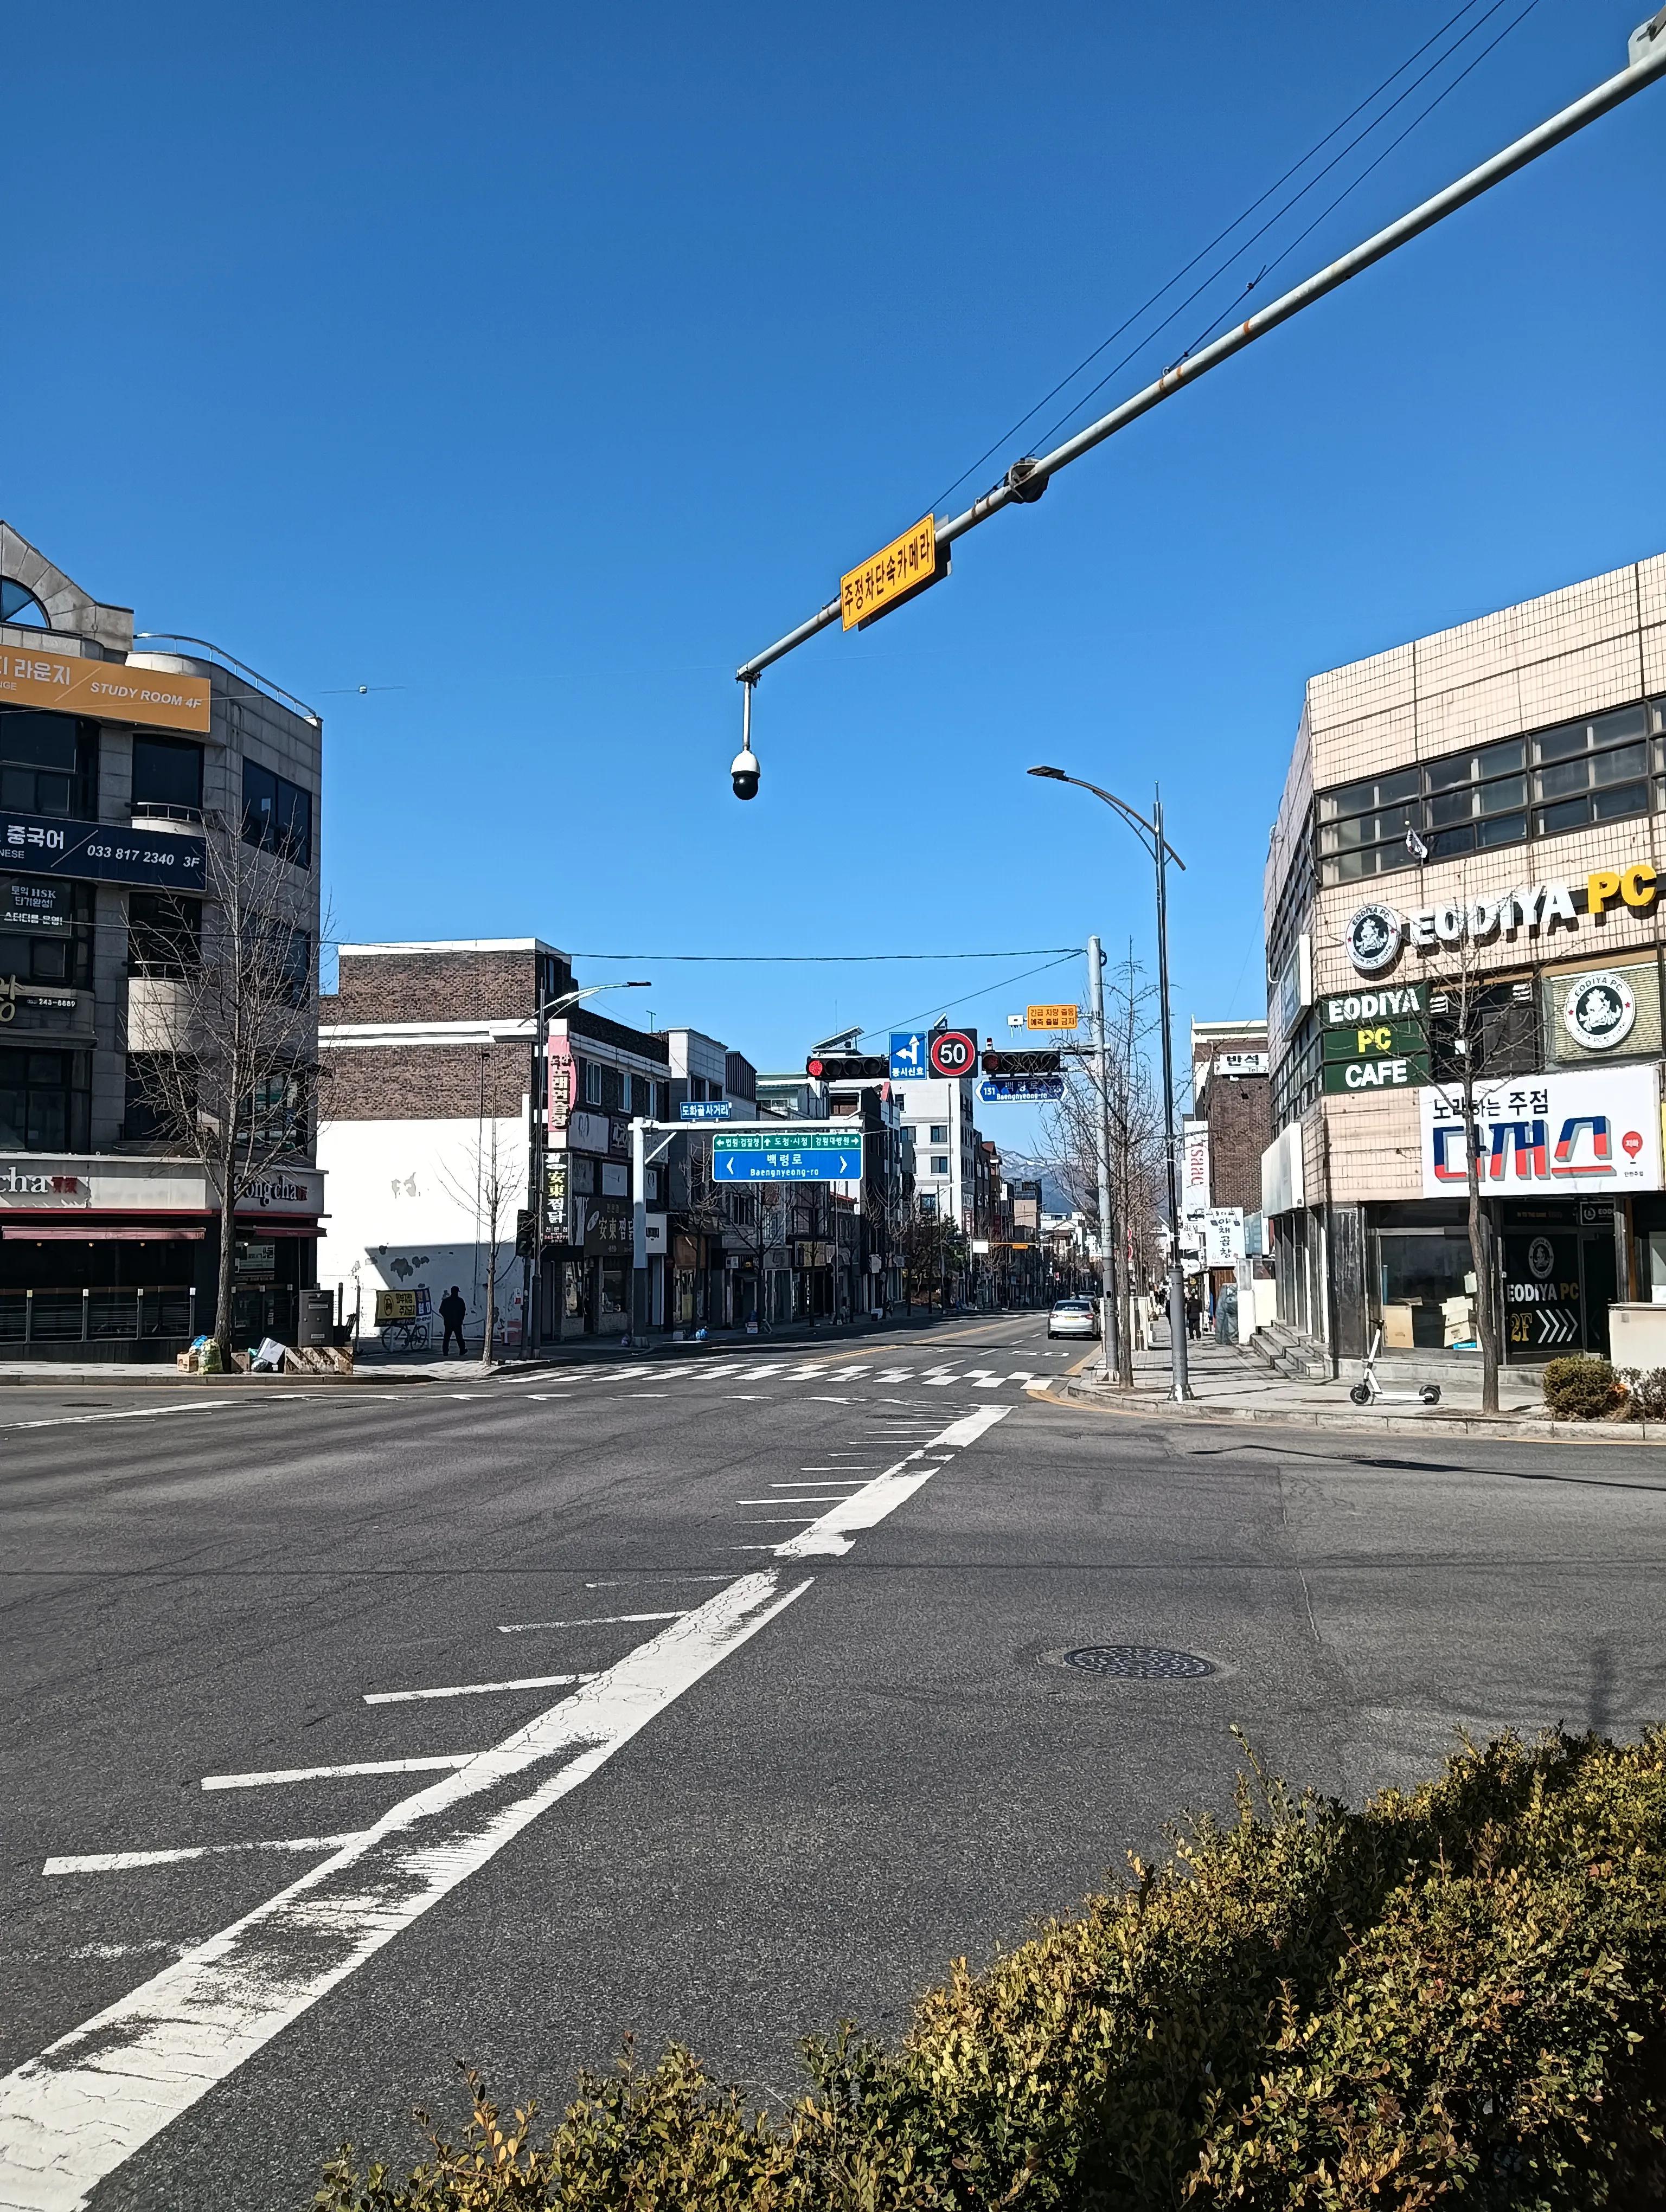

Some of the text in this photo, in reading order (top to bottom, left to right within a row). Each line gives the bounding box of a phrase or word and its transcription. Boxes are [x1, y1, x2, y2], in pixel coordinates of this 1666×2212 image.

[845, 528, 930, 616] 주정차단속카메라
[14, 658, 71, 686] 라운지
[91, 681, 202, 709] STUDY ROOM 4F
[7, 825, 65, 850] 중국어
[87, 845, 200, 867] 033 817 2340 3F
[31, 888, 56, 899] HSK
[1409, 864, 1657, 945] EODIYA PC
[1352, 907, 1389, 925] EODIYA PC
[1574, 976, 1623, 997] EODIYA PC
[1328, 988, 1420, 1023] EODIYA
[1061, 1017, 1074, 1025] 금지
[1357, 1026, 1392, 1053] PC
[940, 1043, 966, 1064] 50
[1227, 1054, 1259, 1066] 반석
[892, 1066, 924, 1077] 동시신호
[1345, 1059, 1408, 1088] CAFE
[983, 1087, 996, 1095] 131
[1508, 1089, 1549, 1116] 주점
[767, 1153, 803, 1167] 백령로
[1190, 1142, 1204, 1185] Isaac
[750, 1168, 819, 1178] Baengnyeong-ro
[274, 1176, 297, 1200] cha
[547, 1171, 567, 1224] 安東찜닭
[1218, 1217, 1232, 1258] 야채곱창
[1506, 1282, 1579, 1302] EODIYA PC
[1510, 1313, 1533, 1342] 2F
